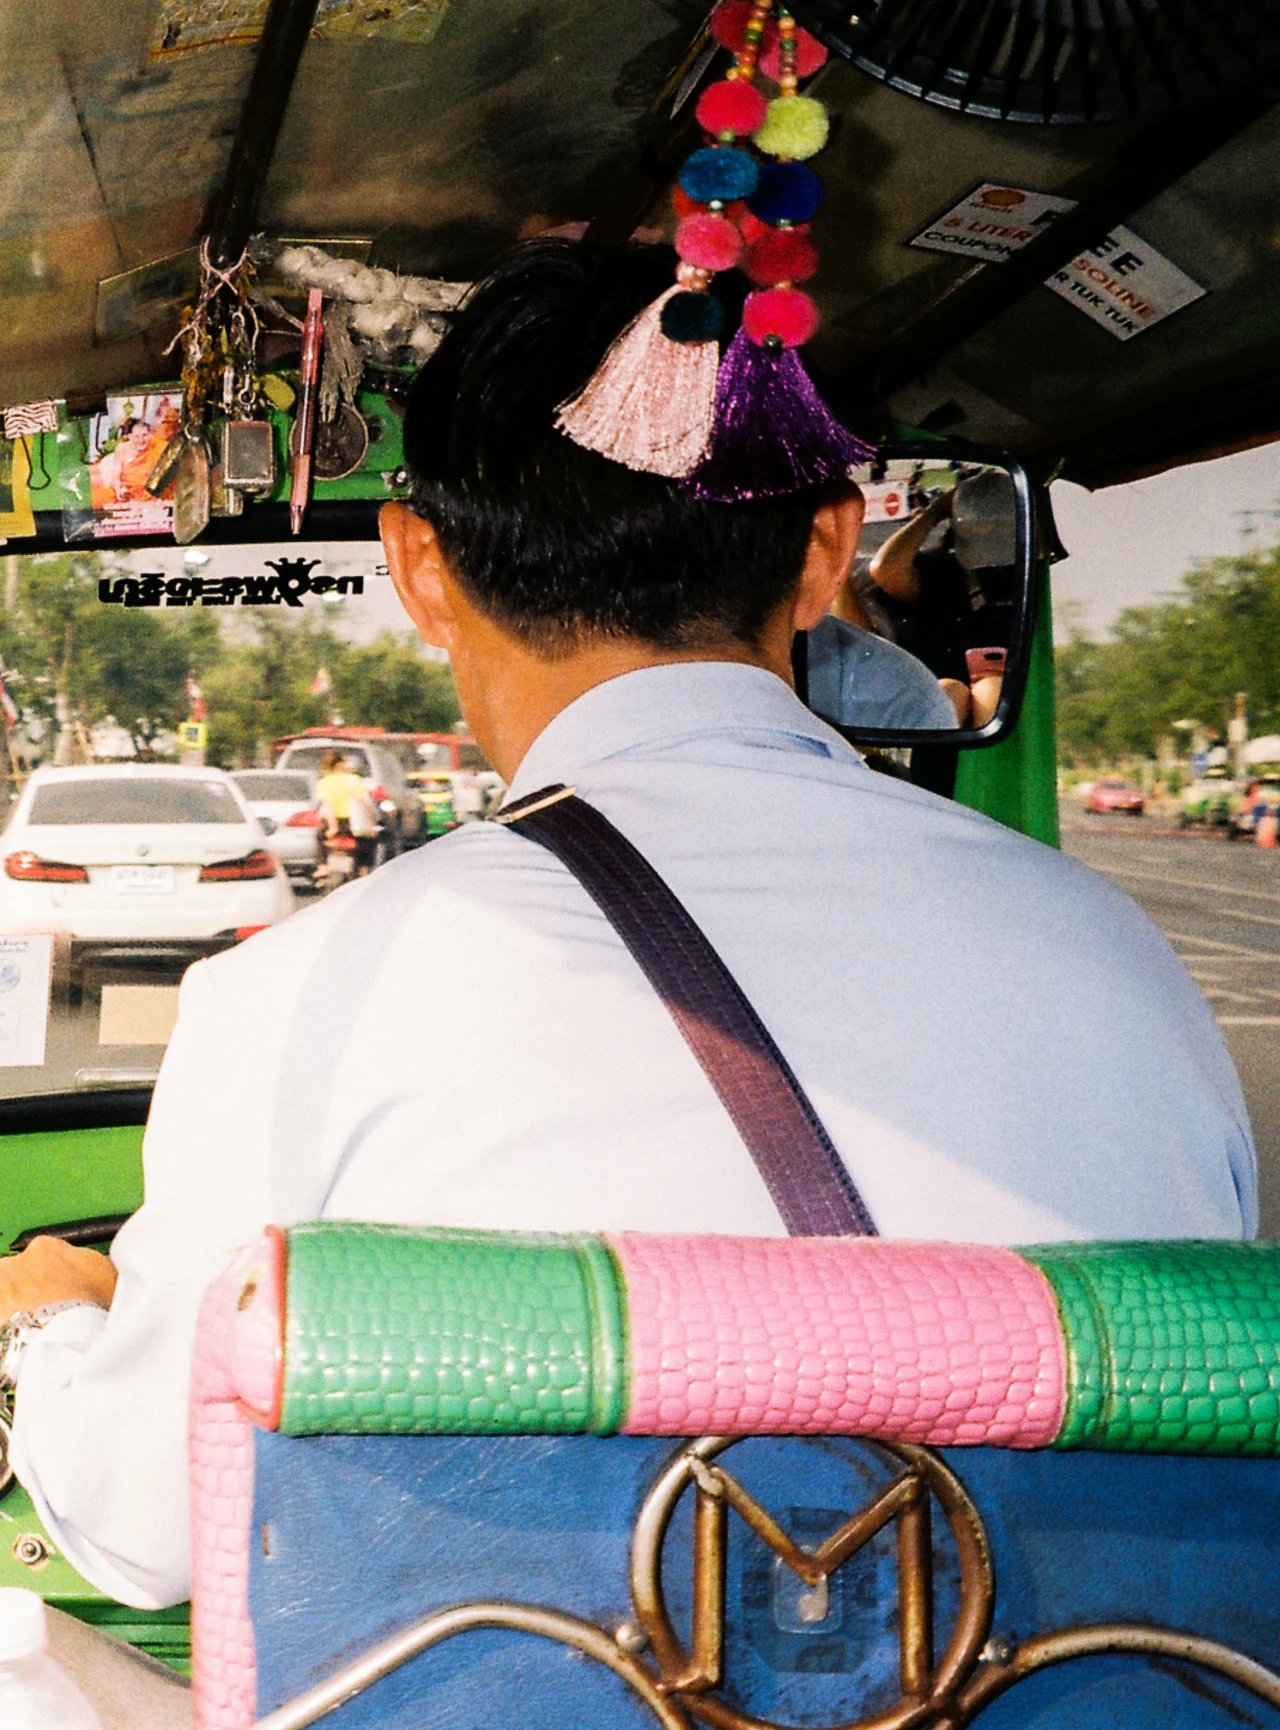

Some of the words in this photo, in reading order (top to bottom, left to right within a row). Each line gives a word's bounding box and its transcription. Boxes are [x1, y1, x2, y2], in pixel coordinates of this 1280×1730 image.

[924, 230, 1022, 256] COUPON
[1070, 279, 1107, 310] TUK
[1105, 305, 1140, 335] TUK
[966, 219, 1033, 242] LITER
[1072, 256, 1155, 319] SOLINE
